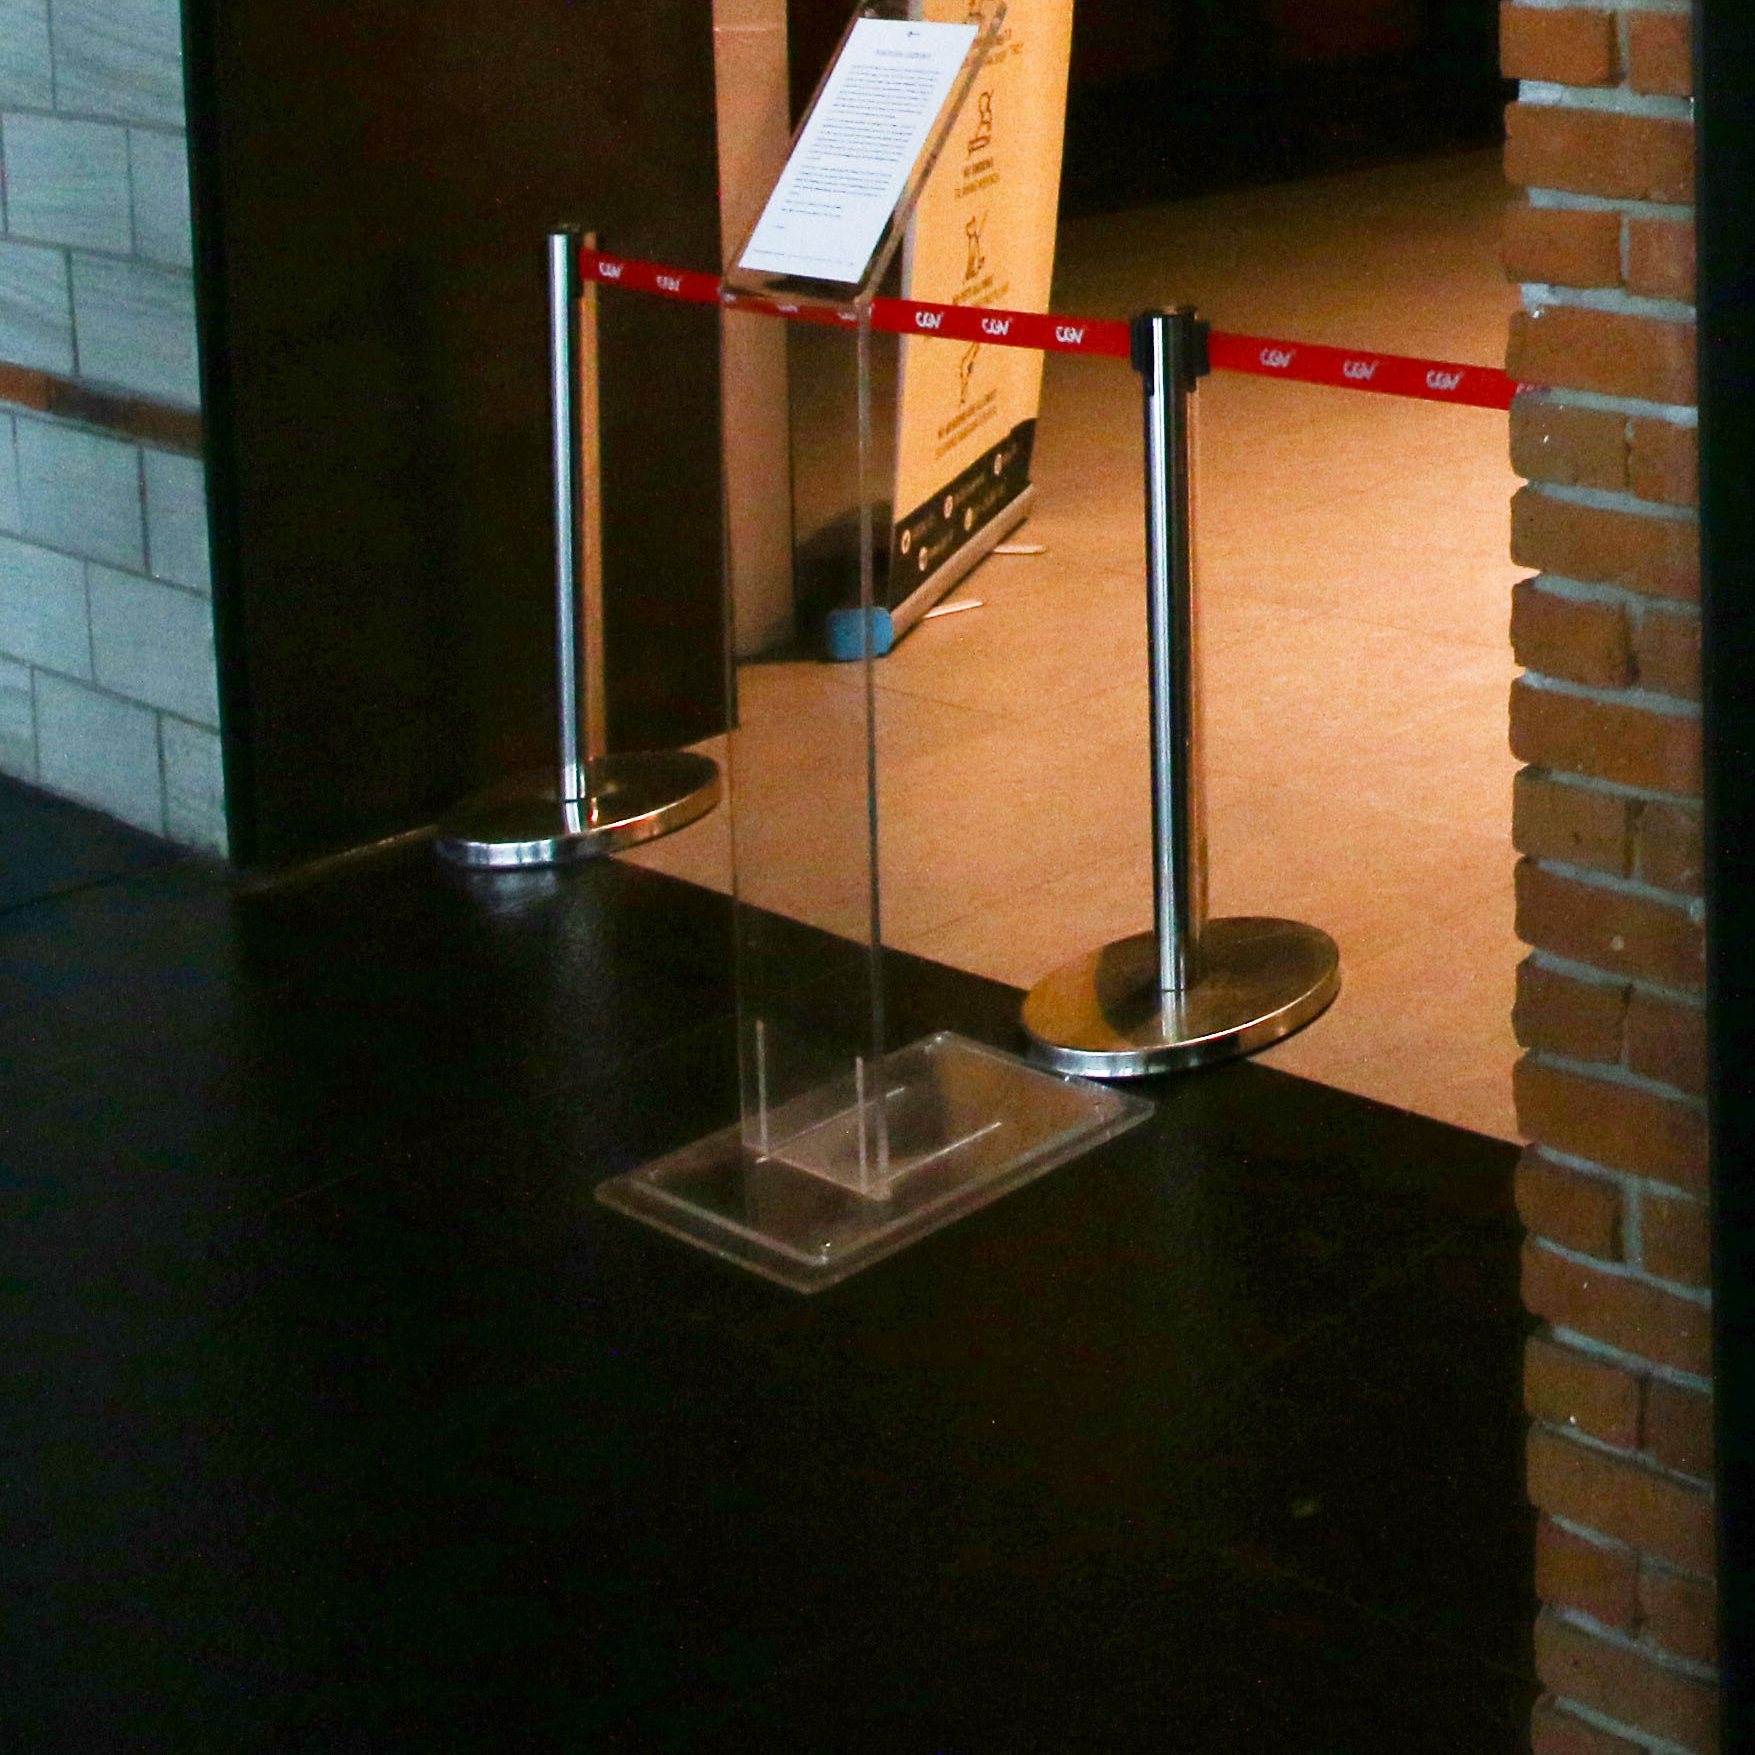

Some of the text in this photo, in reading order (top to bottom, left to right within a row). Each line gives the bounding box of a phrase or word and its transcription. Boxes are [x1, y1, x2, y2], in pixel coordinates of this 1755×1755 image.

[915, 311, 1084, 344] CGV CGV CGV
